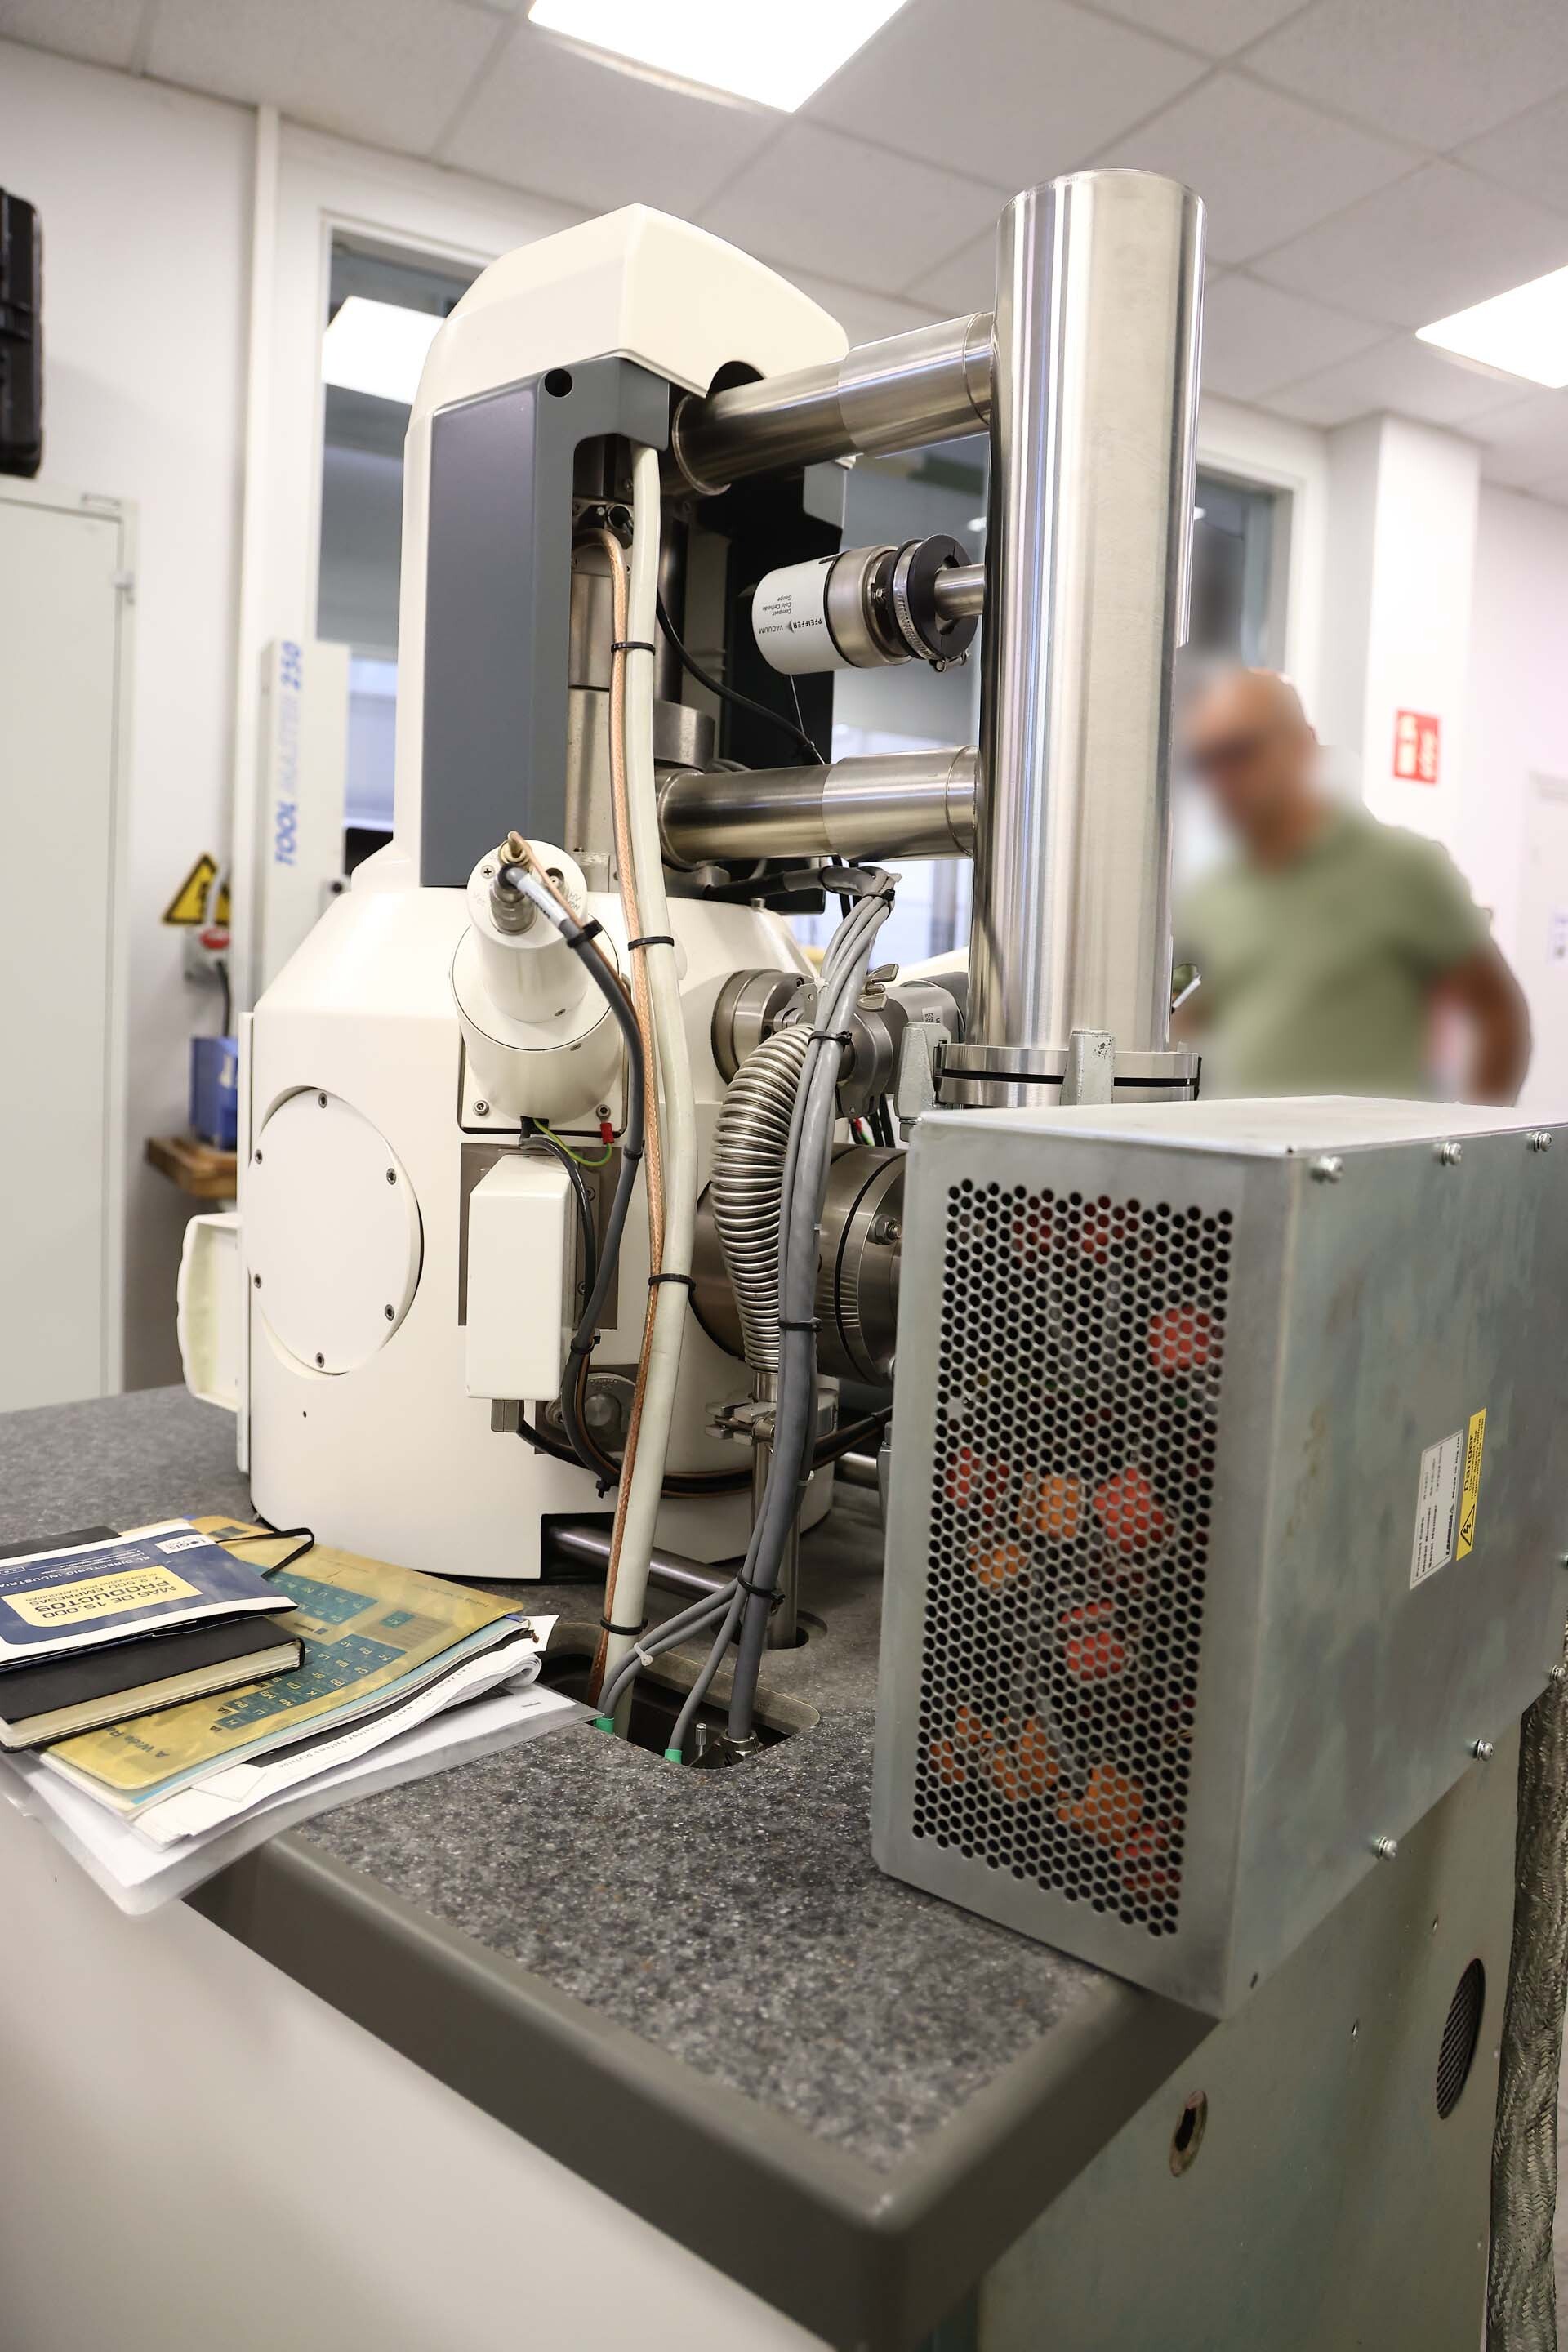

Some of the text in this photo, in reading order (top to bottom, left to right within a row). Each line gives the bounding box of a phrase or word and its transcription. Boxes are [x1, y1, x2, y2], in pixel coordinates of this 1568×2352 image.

[772, 608, 792, 617] Compact
[759, 618, 822, 635] PFEIFFER VACUUM
[280, 641, 302, 690] 250
[274, 801, 298, 866] TOOL
[1463, 1435, 1473, 1492] Danger
[66, 1558, 133, 1575] DIRECTORIO
[0, 1573, 62, 1588] INDUSTRIA
[109, 1578, 149, 1589] 2.500
[29, 1587, 104, 1606] EMPRESAS
[34, 1580, 171, 1612] PRODUCTOS
[112, 1593, 135, 1604] DE
[42, 1601, 106, 1619] 15.000
[260, 1690, 277, 1699] Mg
[234, 1700, 249, 1708] Be
[279, 1699, 295, 1707] Na
[394, 1706, 413, 1718] Nano
[105, 1726, 124, 1738] Ra
[348, 1718, 392, 1740] Technology
[124, 1734, 155, 1753] Wide
[314, 1739, 347, 1753] Systems
[278, 1753, 313, 1768] Division
